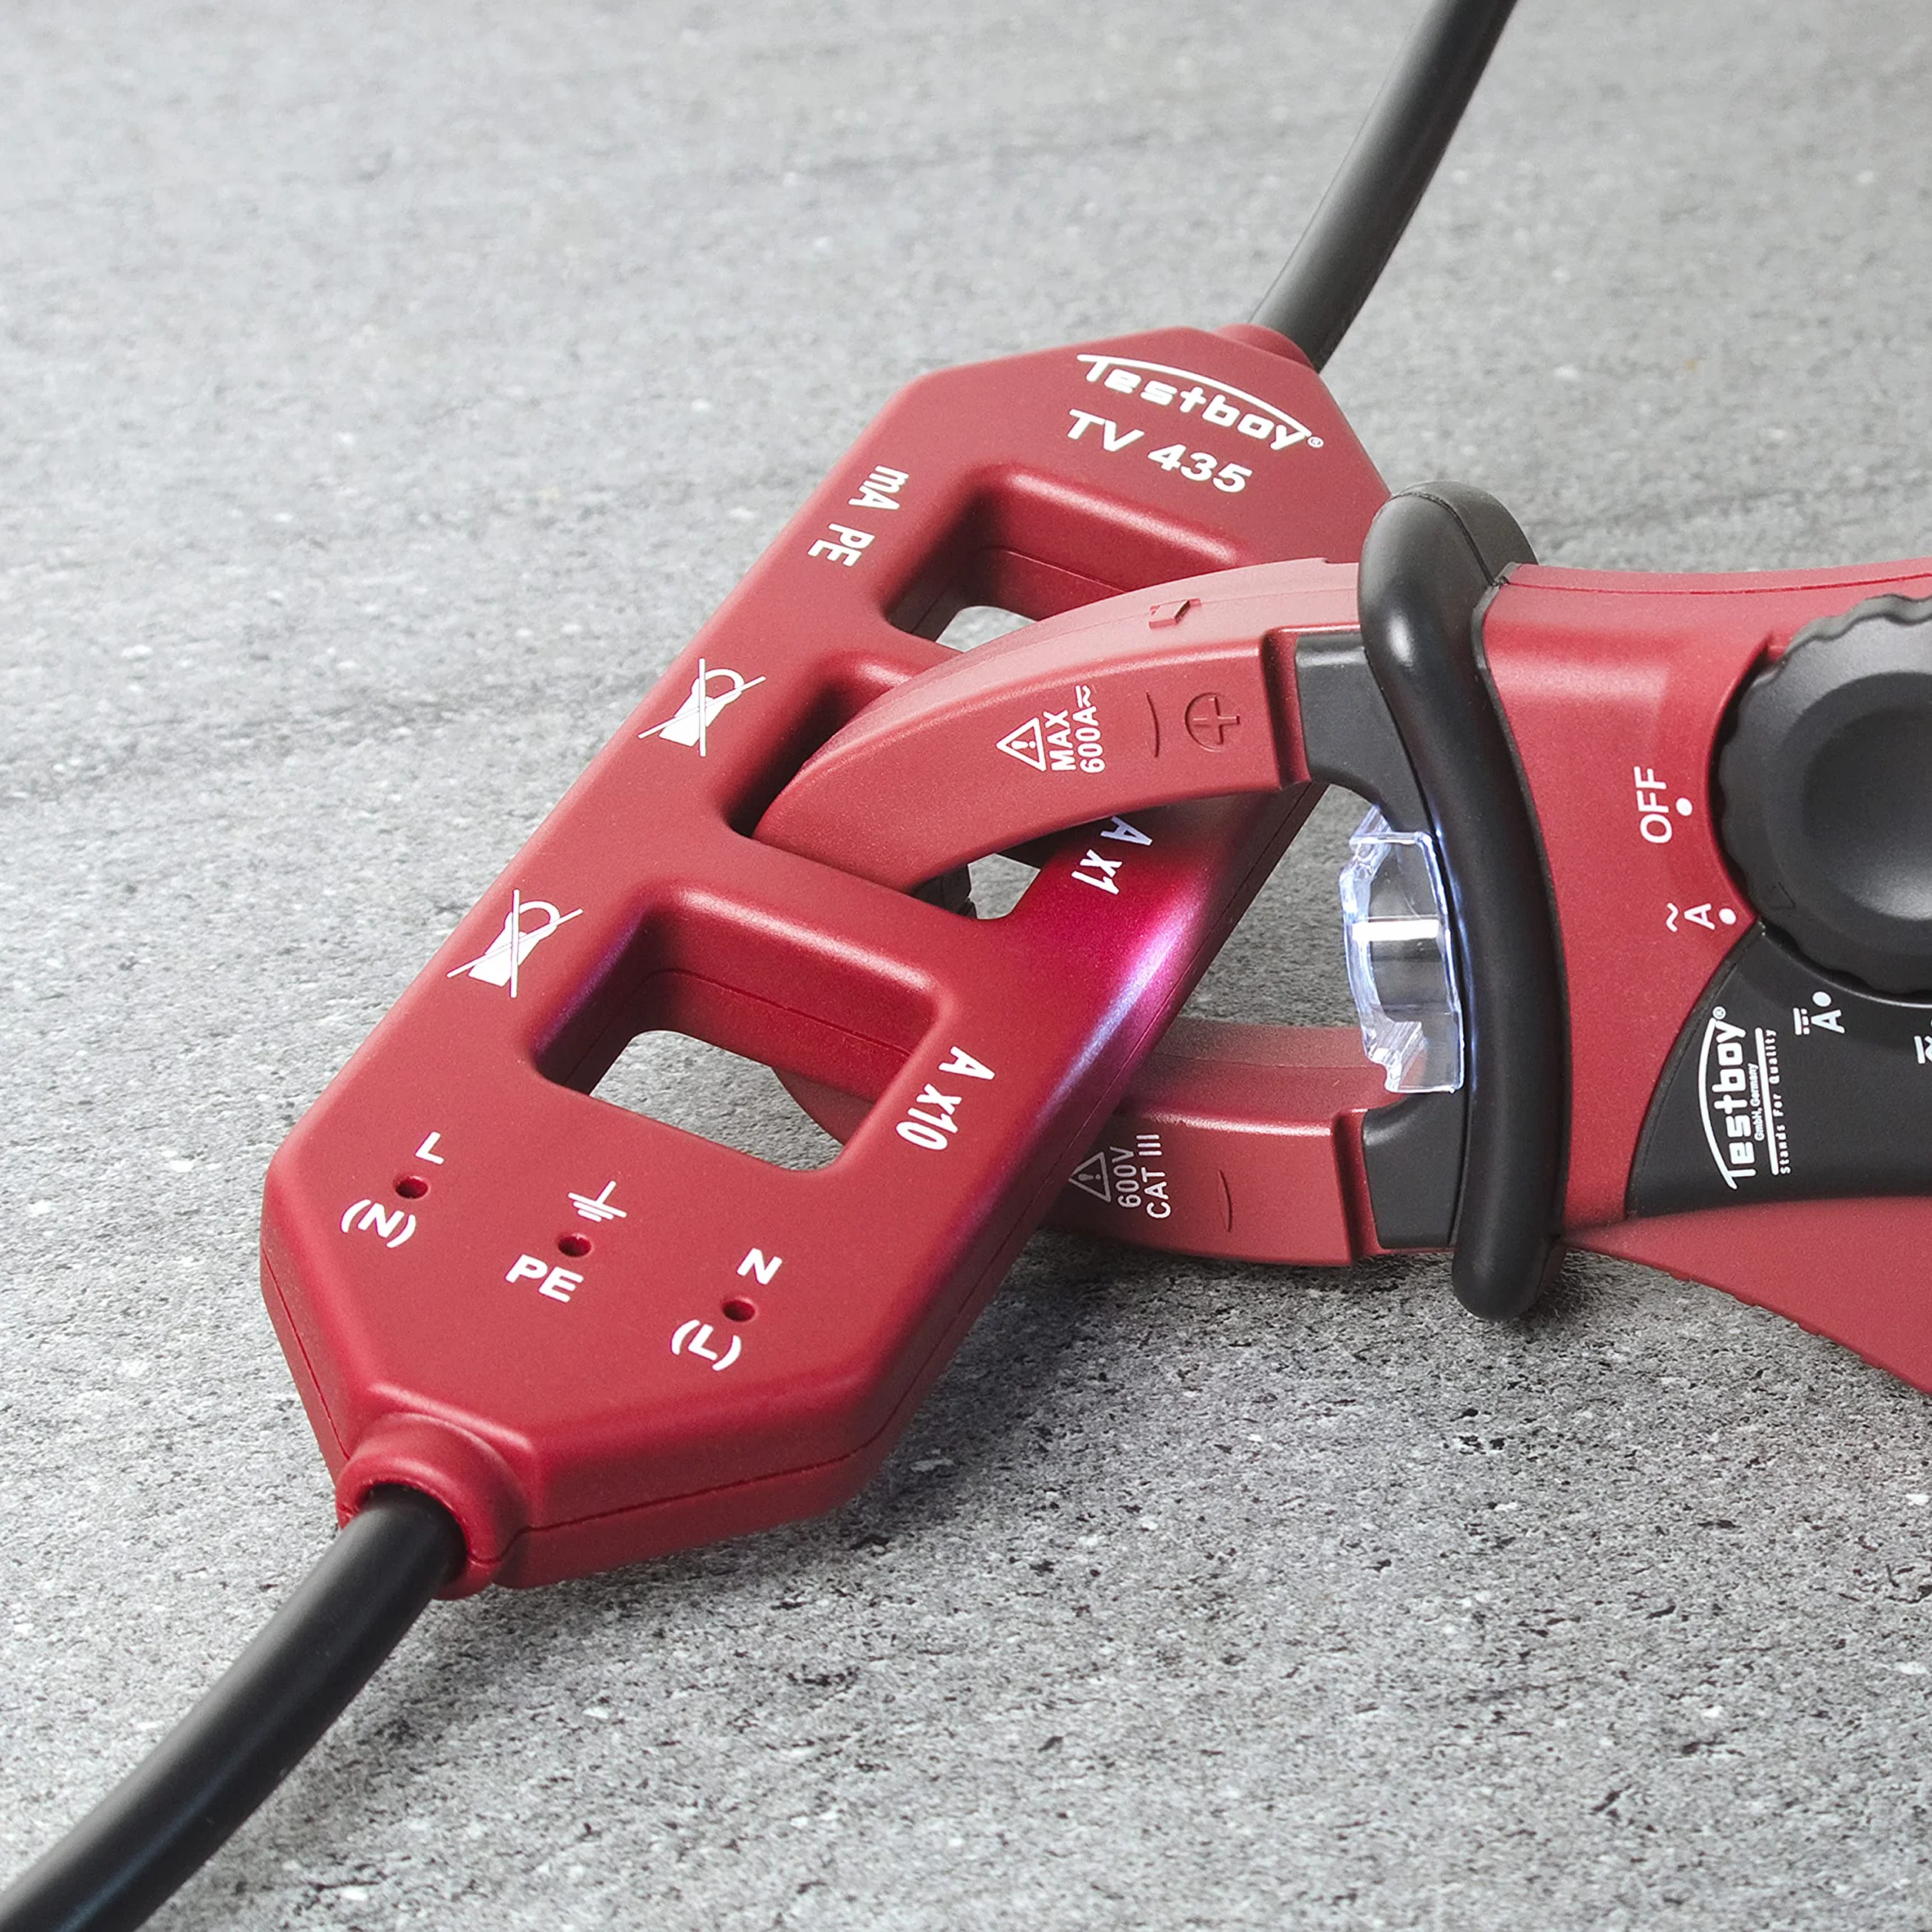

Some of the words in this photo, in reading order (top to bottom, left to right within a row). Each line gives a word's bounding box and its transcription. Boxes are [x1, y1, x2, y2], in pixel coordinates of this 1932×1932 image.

[1076, 353, 1313, 450] Testboy
[1067, 408, 1145, 453] TV
[1147, 443, 1253, 493] 435
[847, 465, 910, 510] mA
[807, 523, 876, 567] PE
[1042, 709, 1078, 771] MAX
[1633, 766, 1673, 844] OFF
[1099, 816, 1153, 846] A
[938, 1045, 996, 1081] A
[1765, 1029, 1780, 1085] Quality
[1698, 1017, 1757, 1190] Testboy
[1747, 1062, 1760, 1107] Germany
[1773, 1093, 1784, 1117] For
[414, 1131, 445, 1165] L
[1136, 1134, 1163, 1156] III
[1776, 1124, 1792, 1175] Stands
[1109, 1145, 1142, 1208] 600V
[1144, 1166, 1172, 1219] CAT
[340, 1198, 417, 1248] (N)
[505, 1253, 584, 1303] PE
[736, 1247, 784, 1285] N
[671, 1319, 742, 1372] (L)
